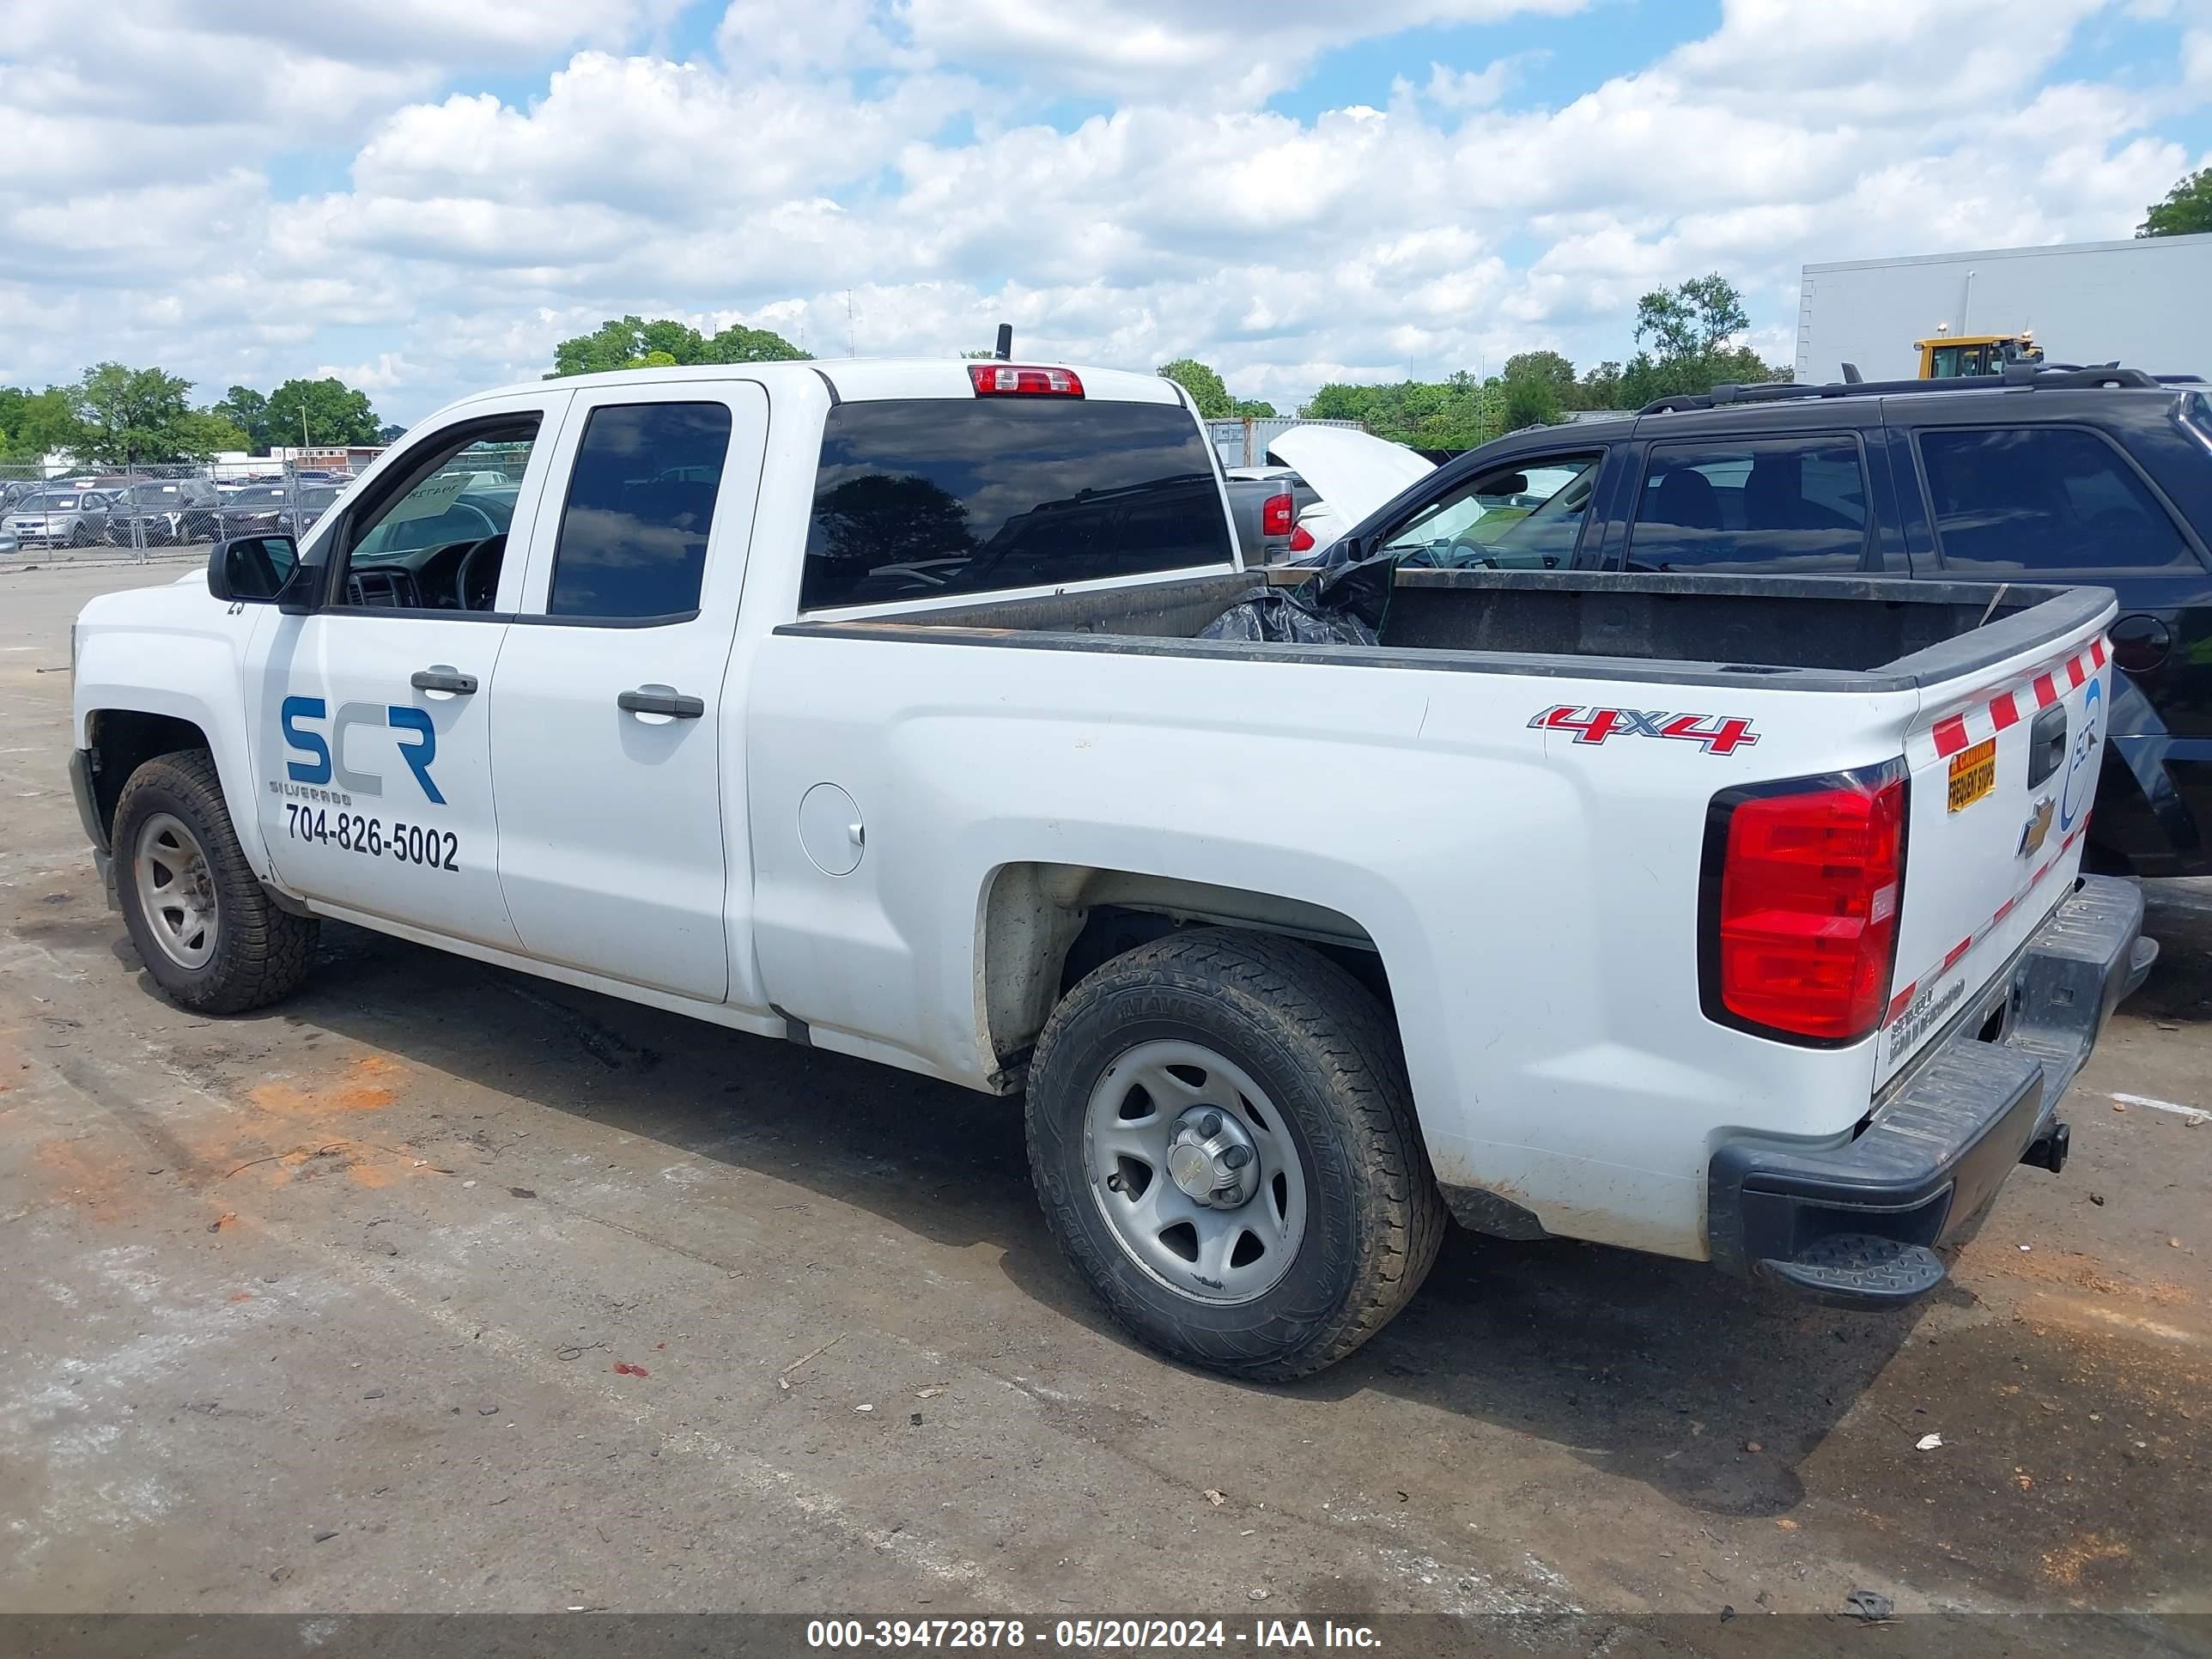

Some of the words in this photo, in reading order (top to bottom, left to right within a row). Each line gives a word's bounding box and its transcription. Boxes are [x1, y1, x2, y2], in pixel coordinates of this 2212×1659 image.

[282, 696, 447, 805] SCR
[1959, 739, 1993, 769] CAUTION
[269, 781, 352, 806] SILVERADO
[1948, 768, 1978, 810] FREQUENT
[1977, 759, 1994, 793] STOPS
[286, 804, 460, 873] 704-826-5002
